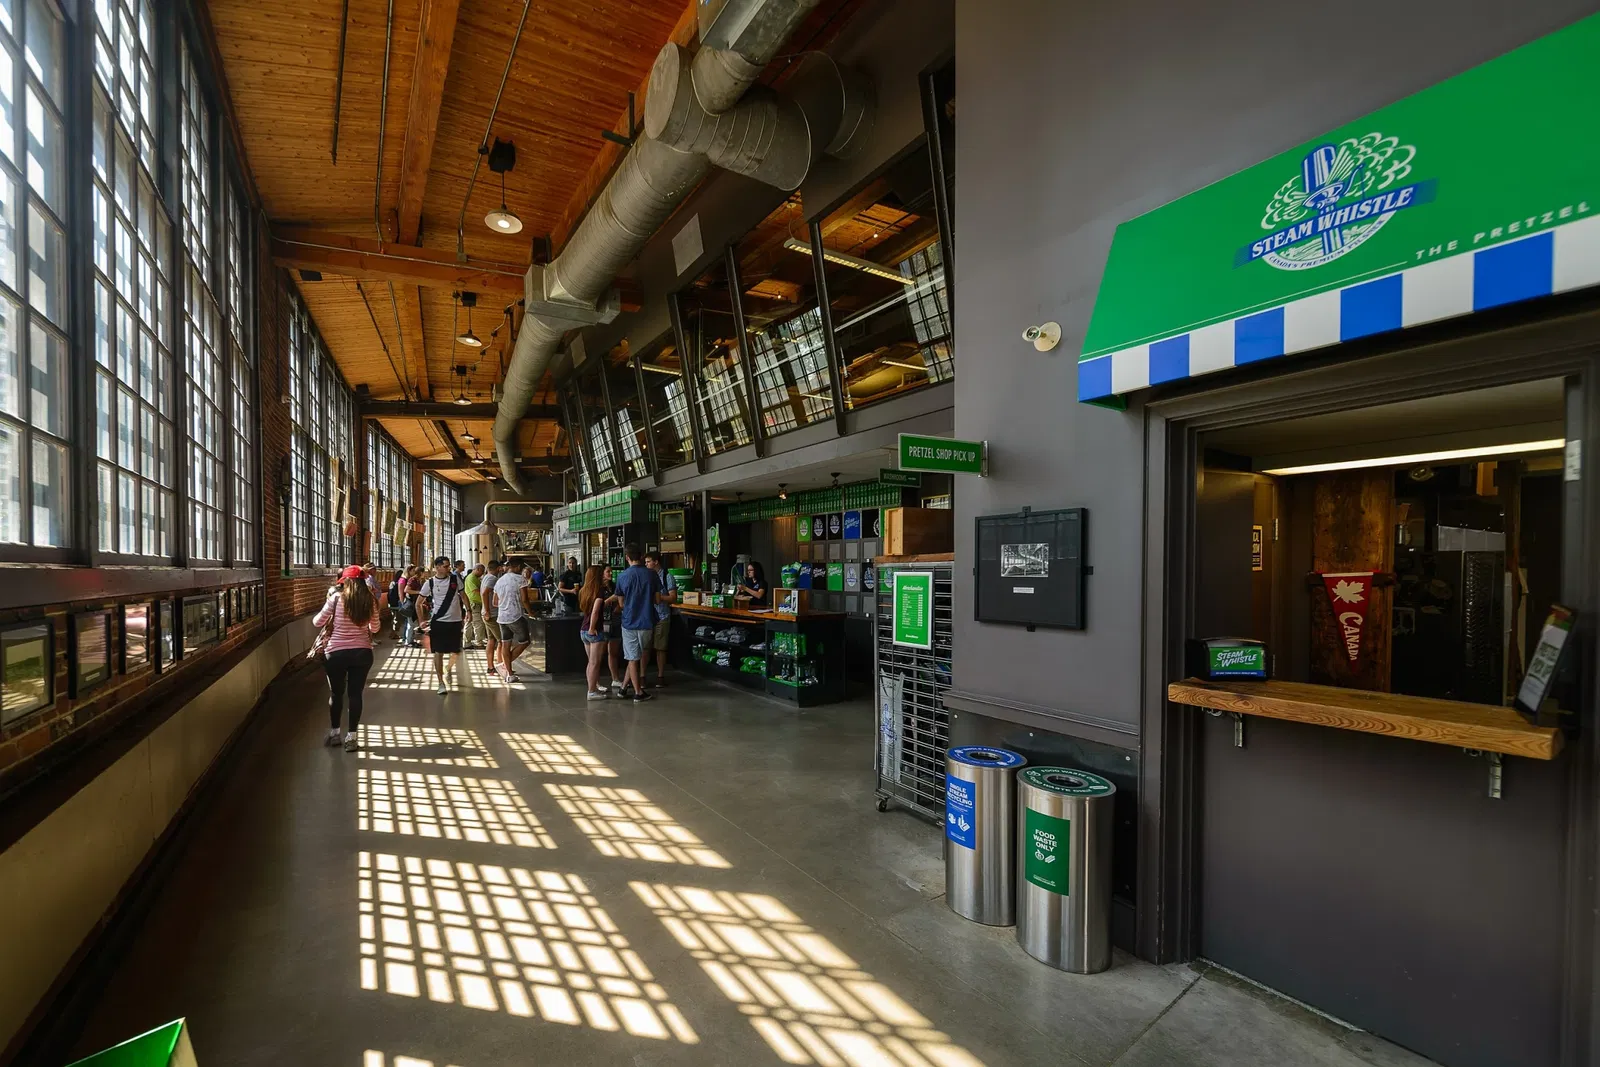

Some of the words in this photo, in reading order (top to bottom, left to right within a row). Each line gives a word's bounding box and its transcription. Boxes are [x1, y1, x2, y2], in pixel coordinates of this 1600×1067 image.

[1252, 220, 1313, 258] STEAM
[1318, 187, 1414, 232] WHISTLE
[1416, 240, 1459, 260] THE
[1473, 201, 1590, 244] PRETZEL
[1300, 249, 1345, 268] PREMIUM
[909, 446, 935, 459] PRETZEL
[936, 448, 952, 460] SHOP
[953, 450, 966, 462] PICK
[967, 451, 976, 463] UP
[1339, 611, 1364, 661] CANADA
[1216, 650, 1244, 661] STEAM
[1221, 654, 1257, 668] WHISTLE
[949, 788, 968, 799] STREAM
[950, 783, 966, 793] SINGLE
[947, 792, 972, 806] RECYCLING
[1033, 834, 1057, 847] WASTE
[1034, 829, 1055, 840] FOOD
[1036, 841, 1054, 852] ONLY
